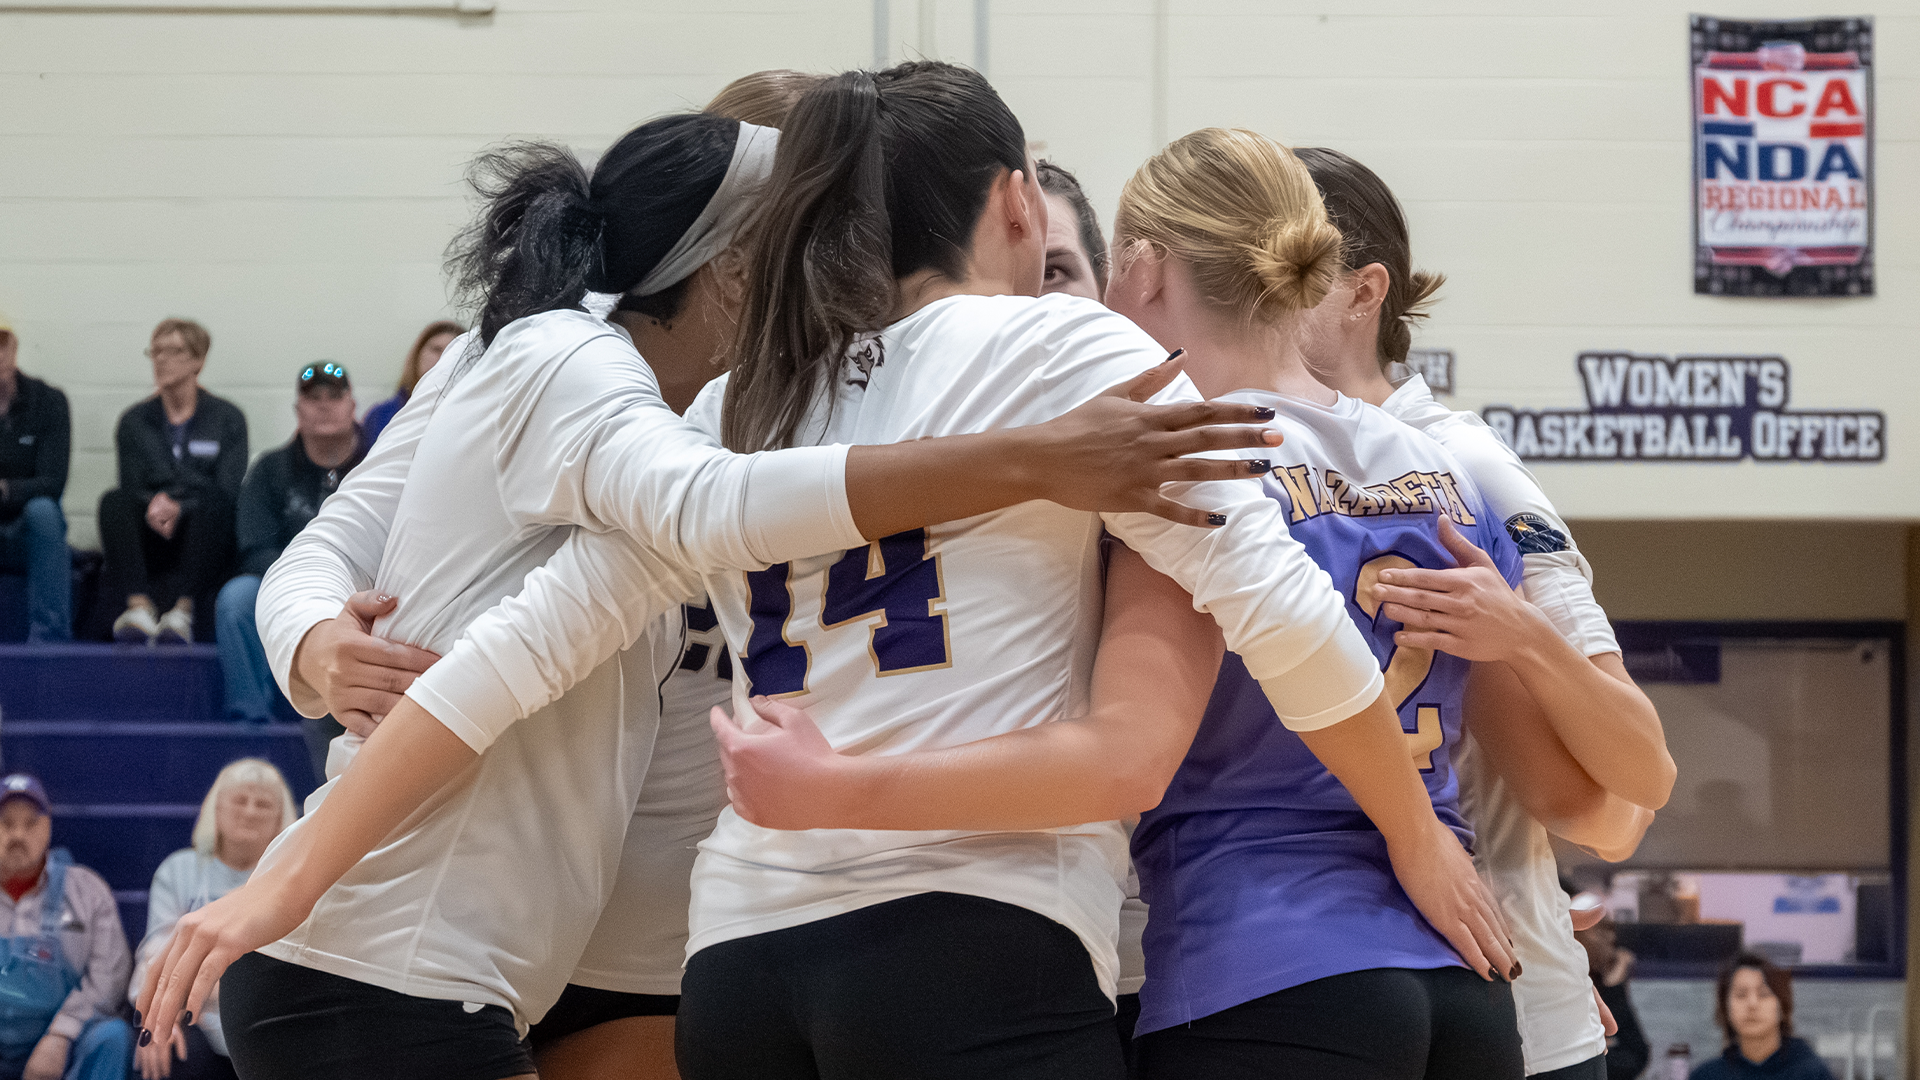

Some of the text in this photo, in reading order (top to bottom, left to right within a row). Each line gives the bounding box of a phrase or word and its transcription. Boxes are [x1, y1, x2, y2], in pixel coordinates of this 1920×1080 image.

[1702, 78, 1859, 119] NCA
[1704, 141, 1861, 182] NDA
[1704, 186, 1866, 211] REGIONAL
[1582, 358, 1785, 408] WOMEN'S
[1750, 410, 1881, 458] OFFICE
[741, 526, 953, 698] 14
